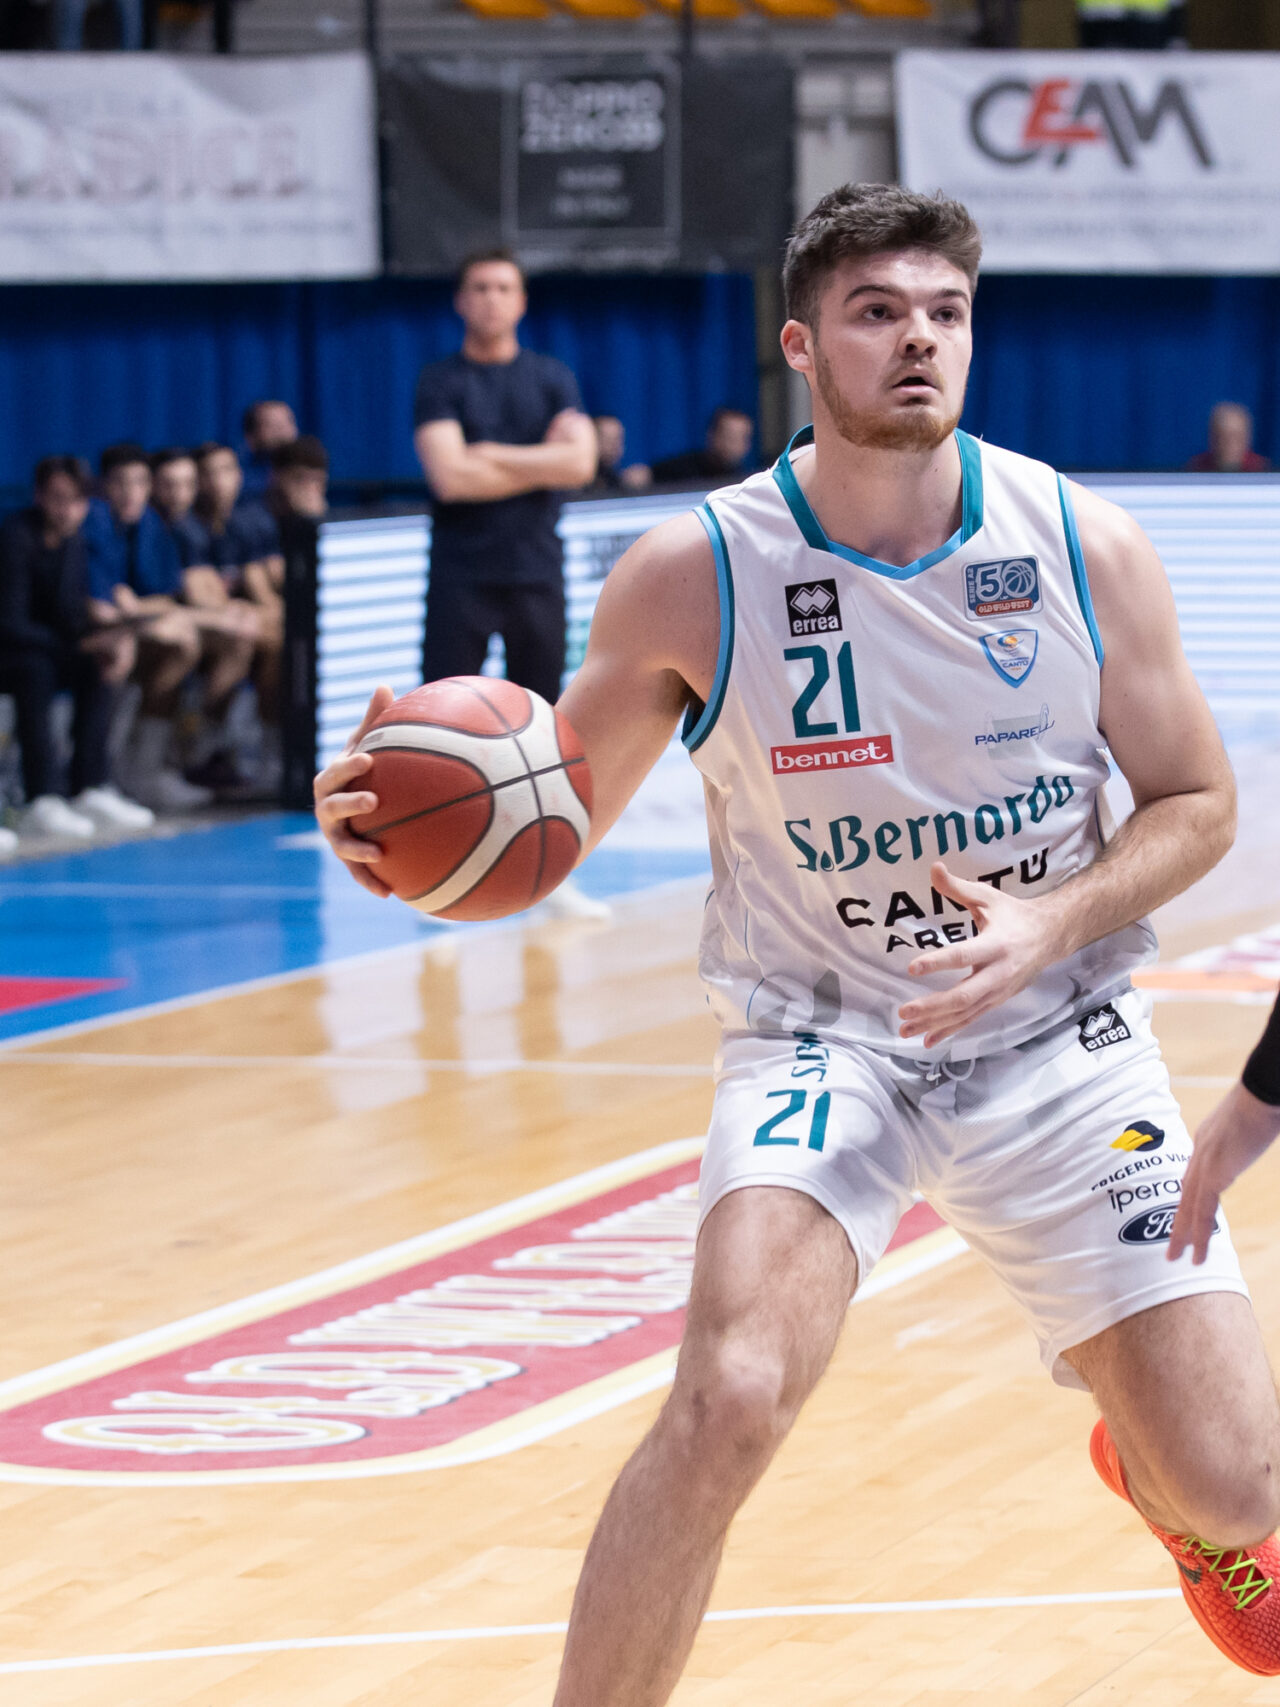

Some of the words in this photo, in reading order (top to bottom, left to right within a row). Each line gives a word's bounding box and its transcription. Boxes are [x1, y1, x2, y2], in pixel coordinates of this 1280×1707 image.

[965, 75, 1217, 171] CEAM
[783, 641, 861, 738] 21
[775, 741, 889, 770] bennet
[785, 774, 1075, 873] S.Bernardo
[753, 1089, 831, 1153] 21
